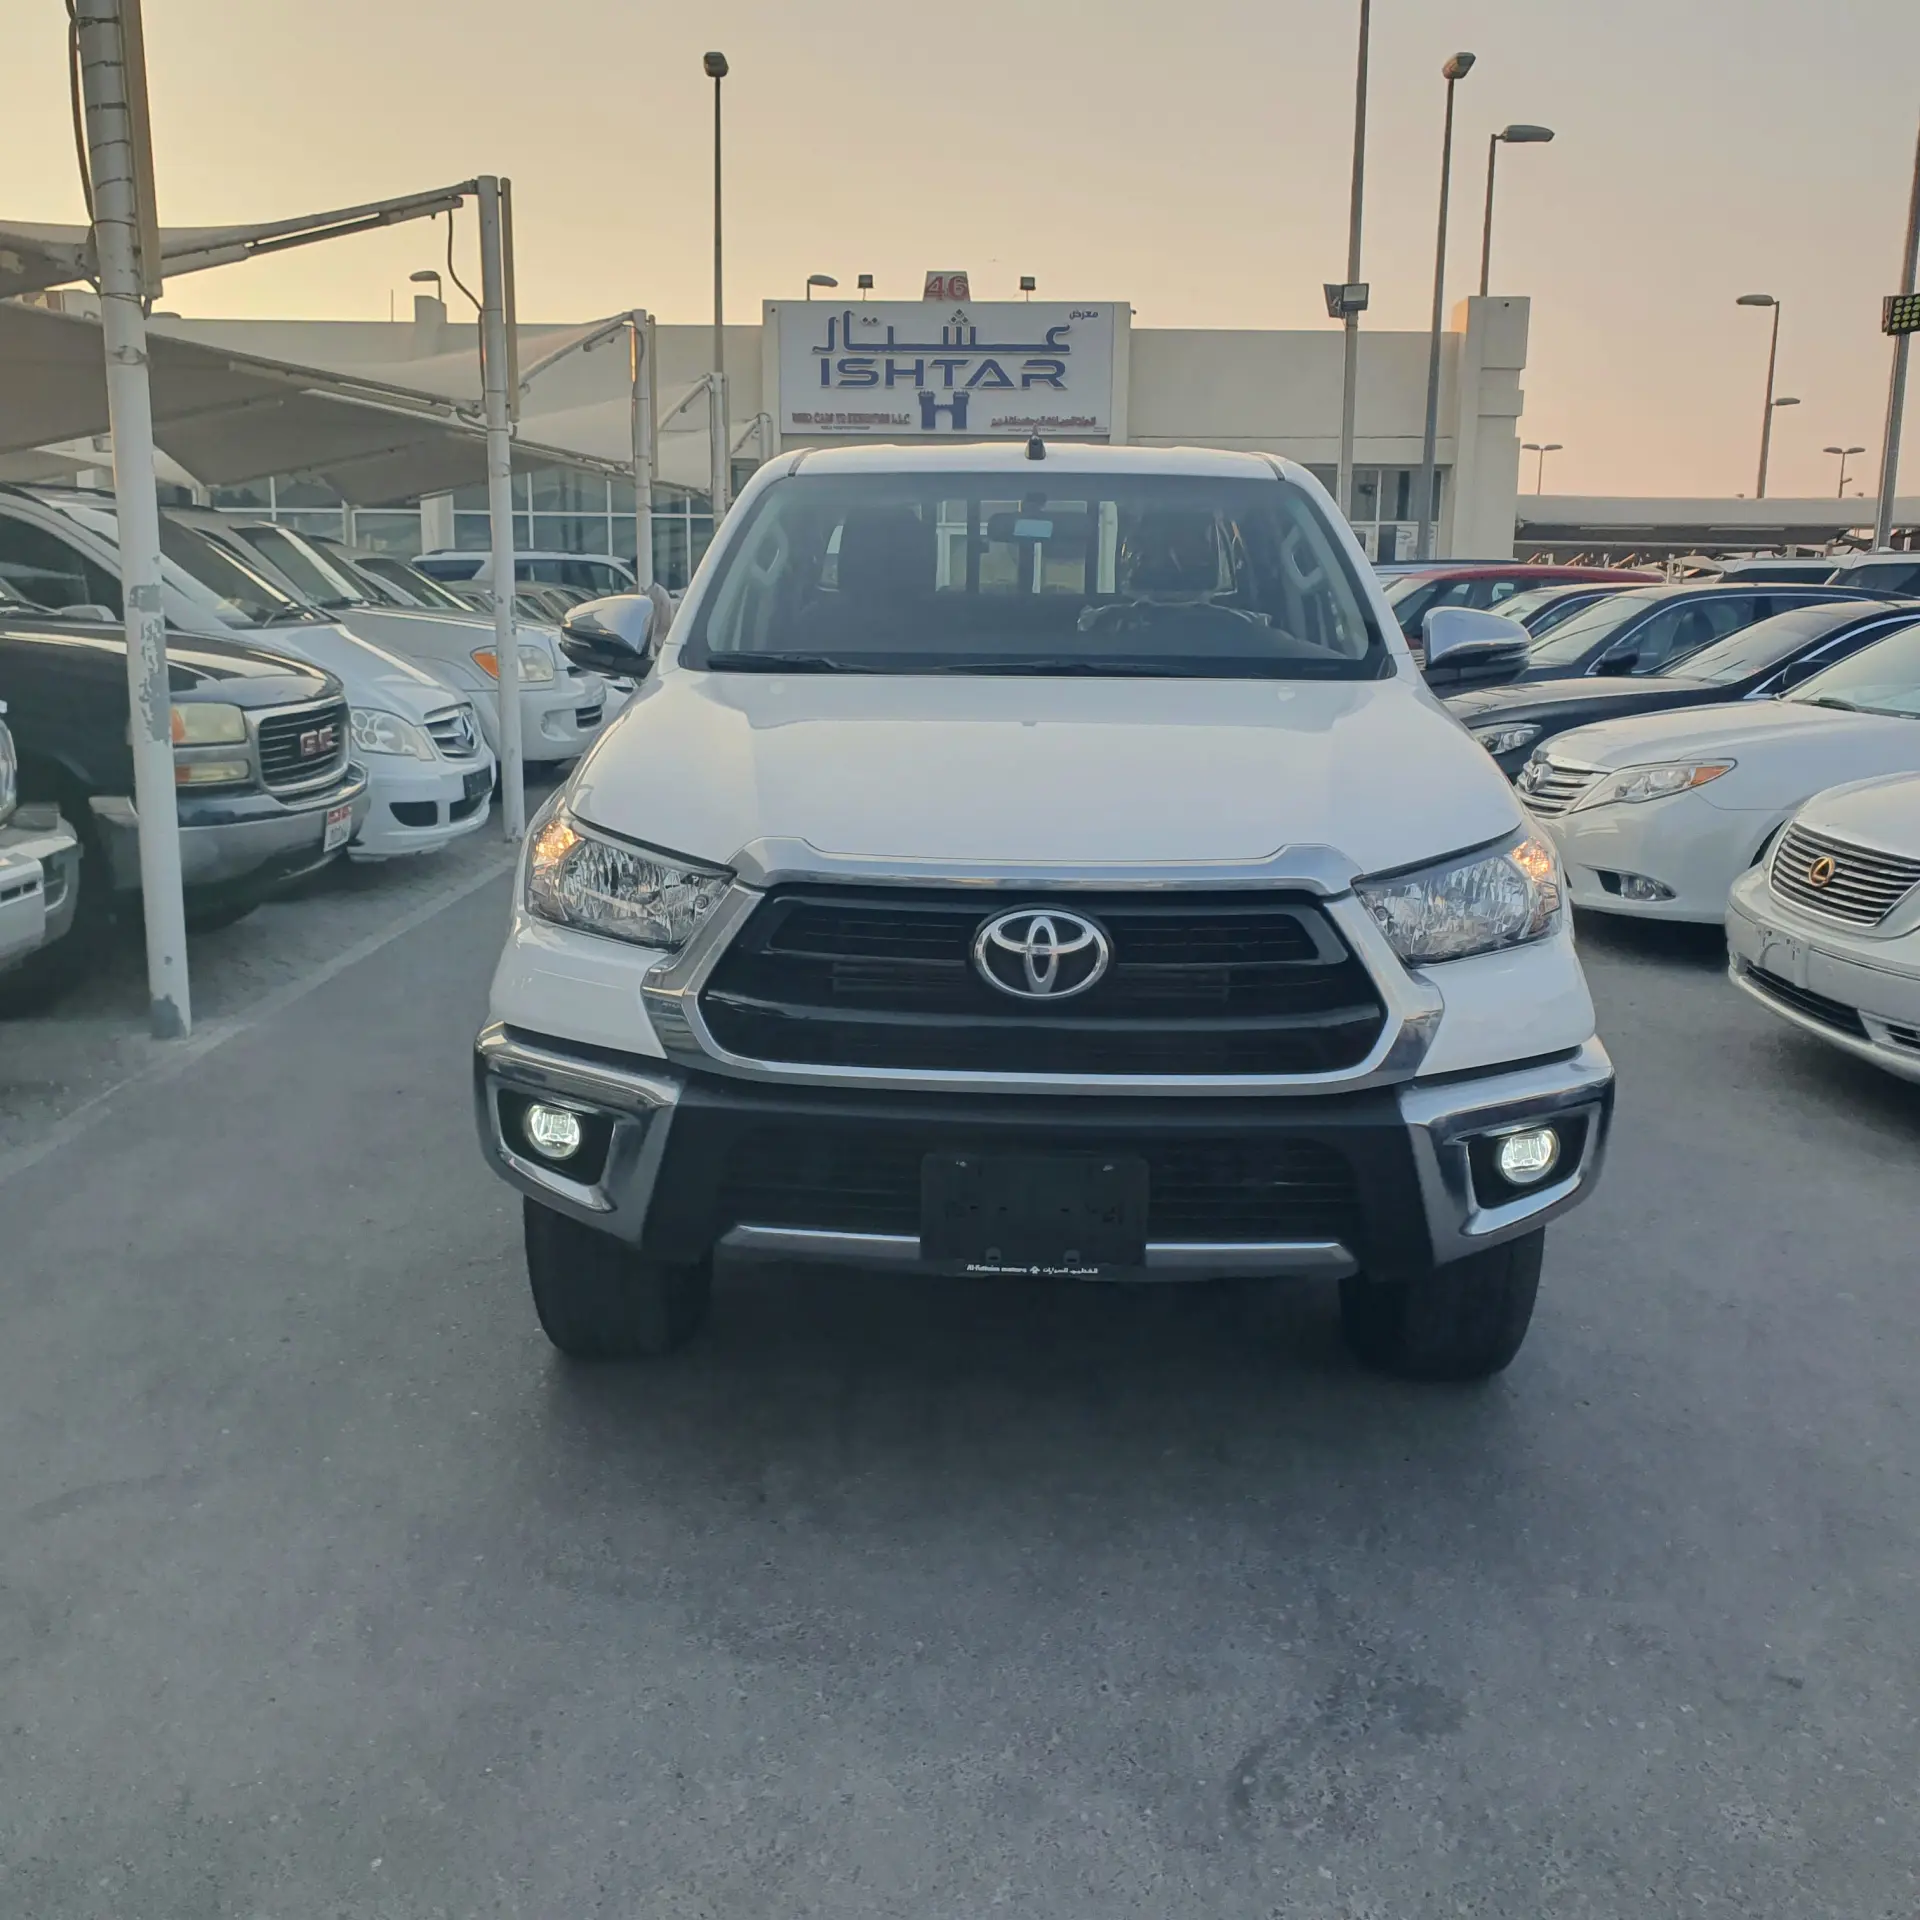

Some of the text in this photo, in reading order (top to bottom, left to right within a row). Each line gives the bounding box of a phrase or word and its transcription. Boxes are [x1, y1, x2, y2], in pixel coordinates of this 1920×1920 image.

[926, 275, 968, 300] 46
[812, 309, 1071, 353] عشتار
[820, 358, 1067, 389] ISHTAR
